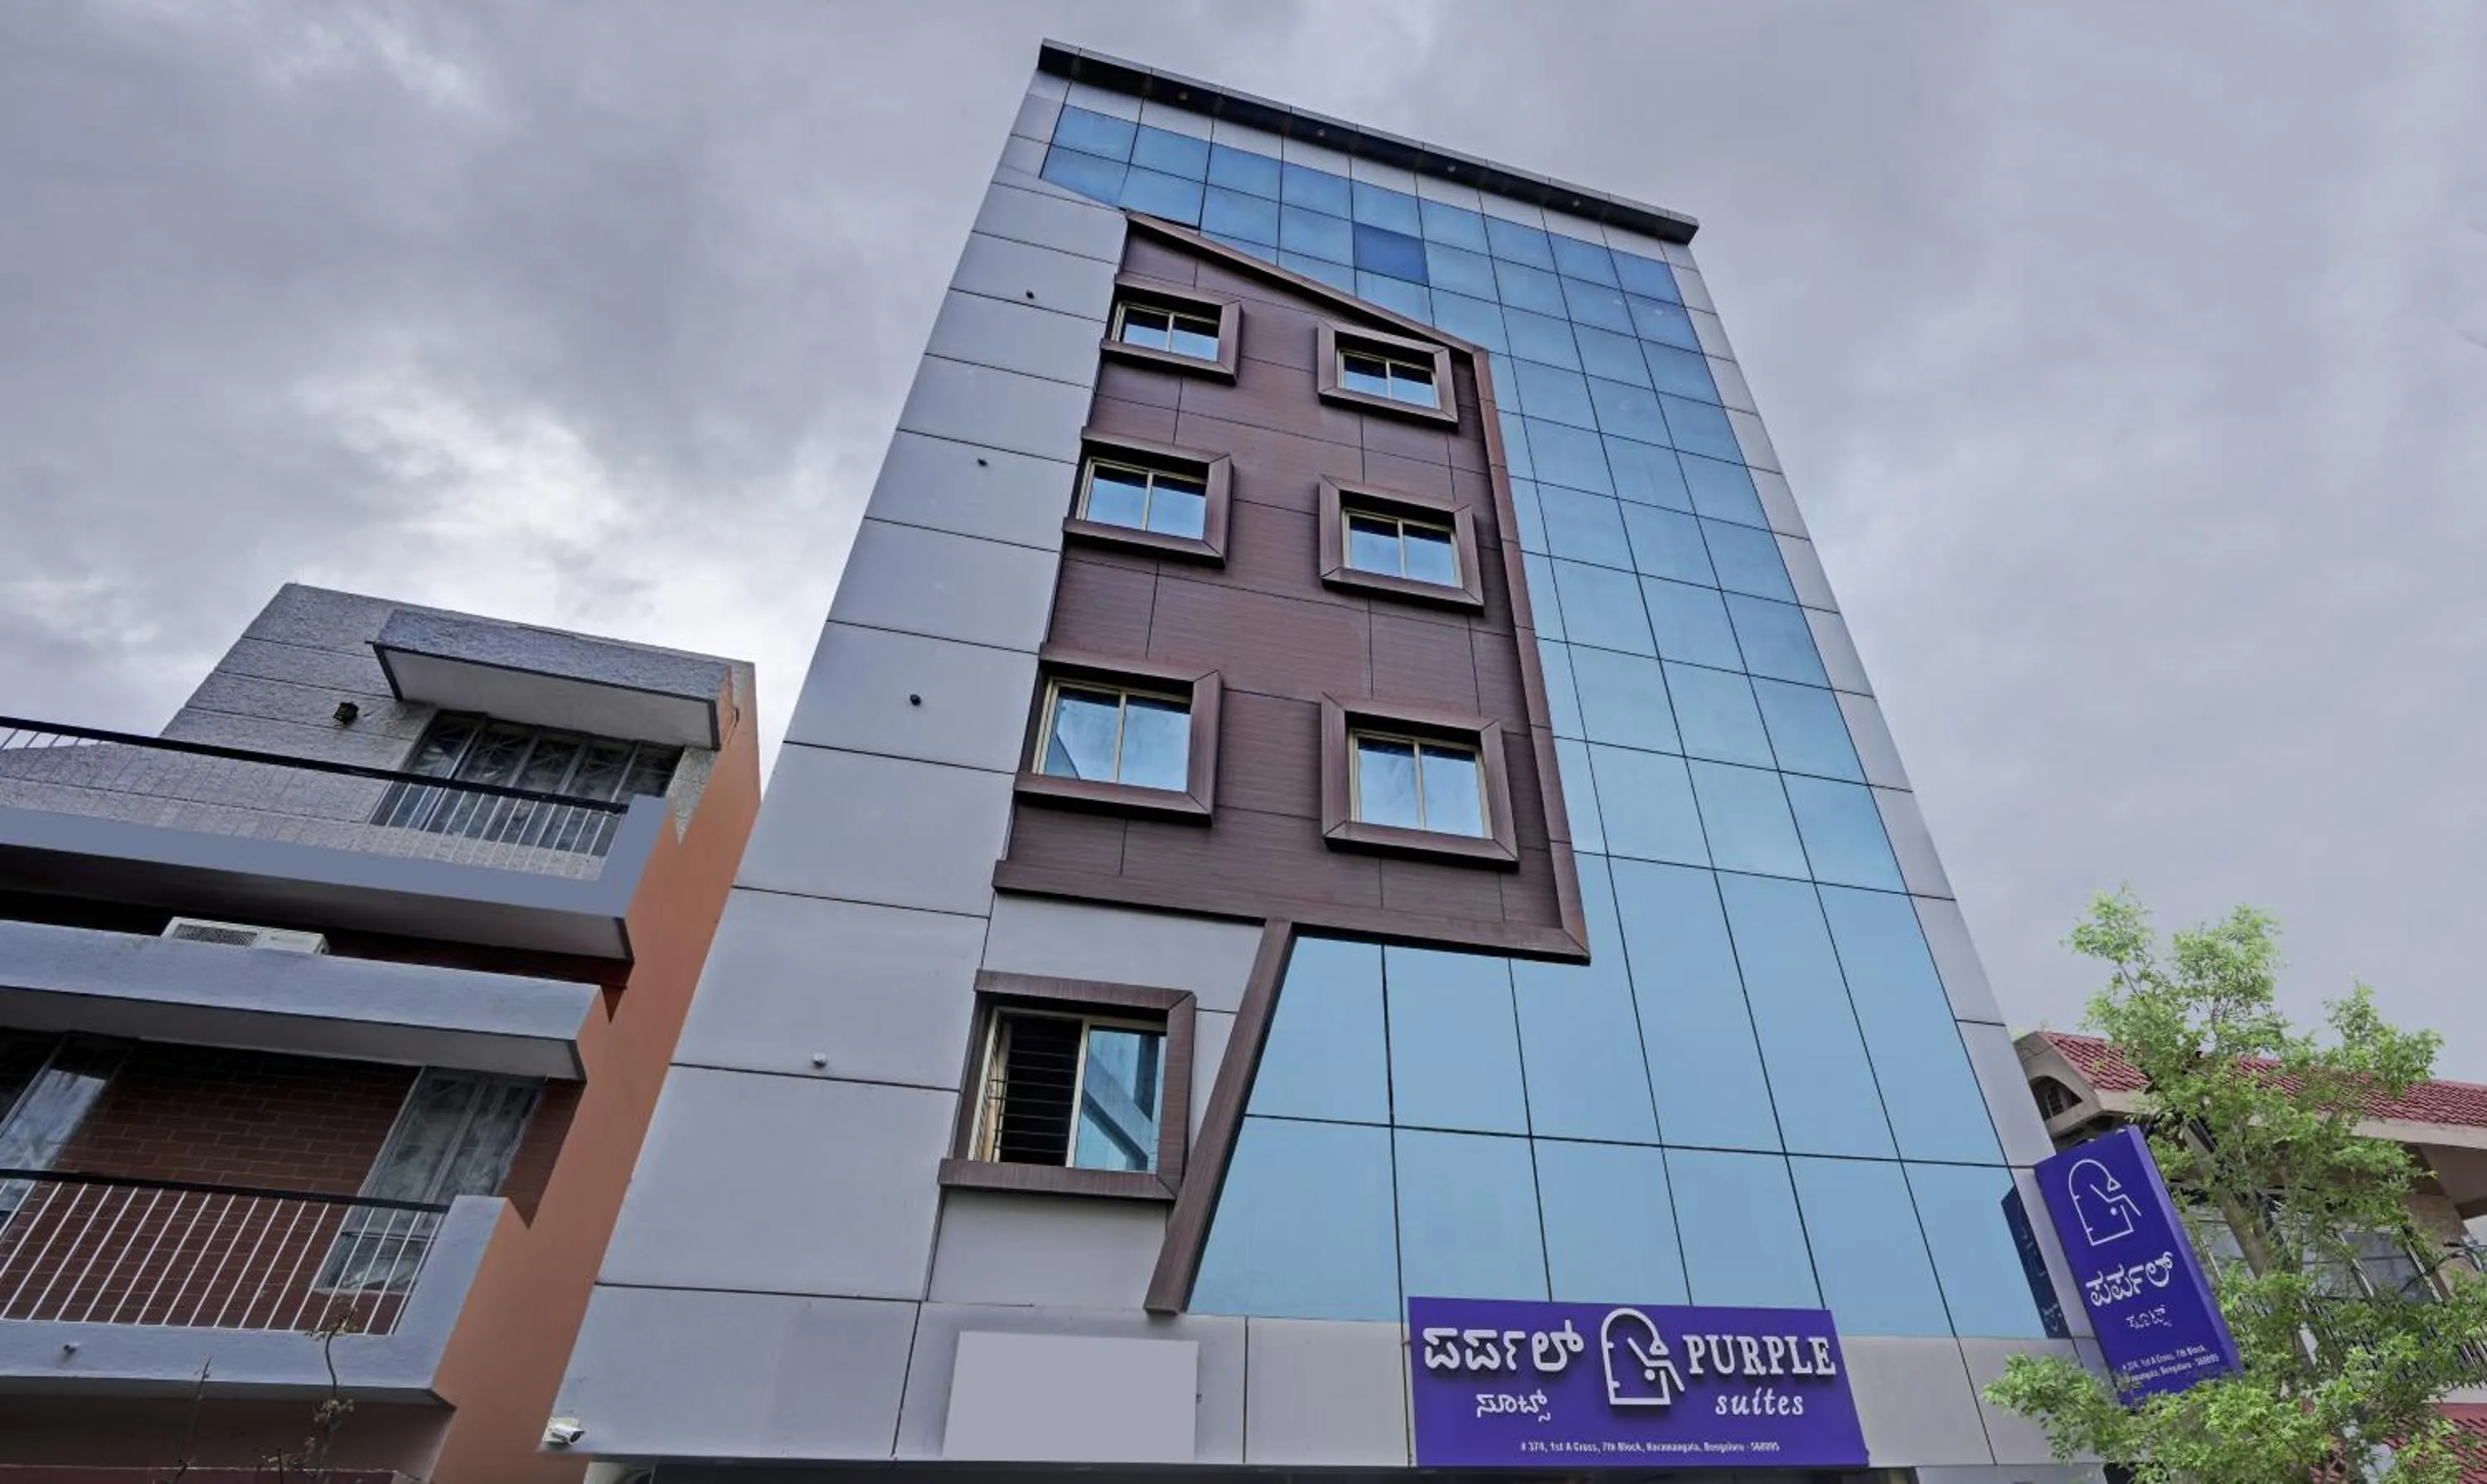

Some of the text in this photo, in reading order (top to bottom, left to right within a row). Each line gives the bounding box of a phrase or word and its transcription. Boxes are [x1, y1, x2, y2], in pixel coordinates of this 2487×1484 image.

[2085, 1250, 2173, 1307] ಪರ್ಪಲ್
[1423, 1319, 1585, 1372] ಪರ್ಪಲ್
[1682, 1334, 1837, 1376] PURPLE
[1715, 1385, 1804, 1415] suites
[1549, 1441, 1564, 1452] 1st
[1566, 1441, 1573, 1452] A
[1602, 1441, 1616, 1452] 7th
